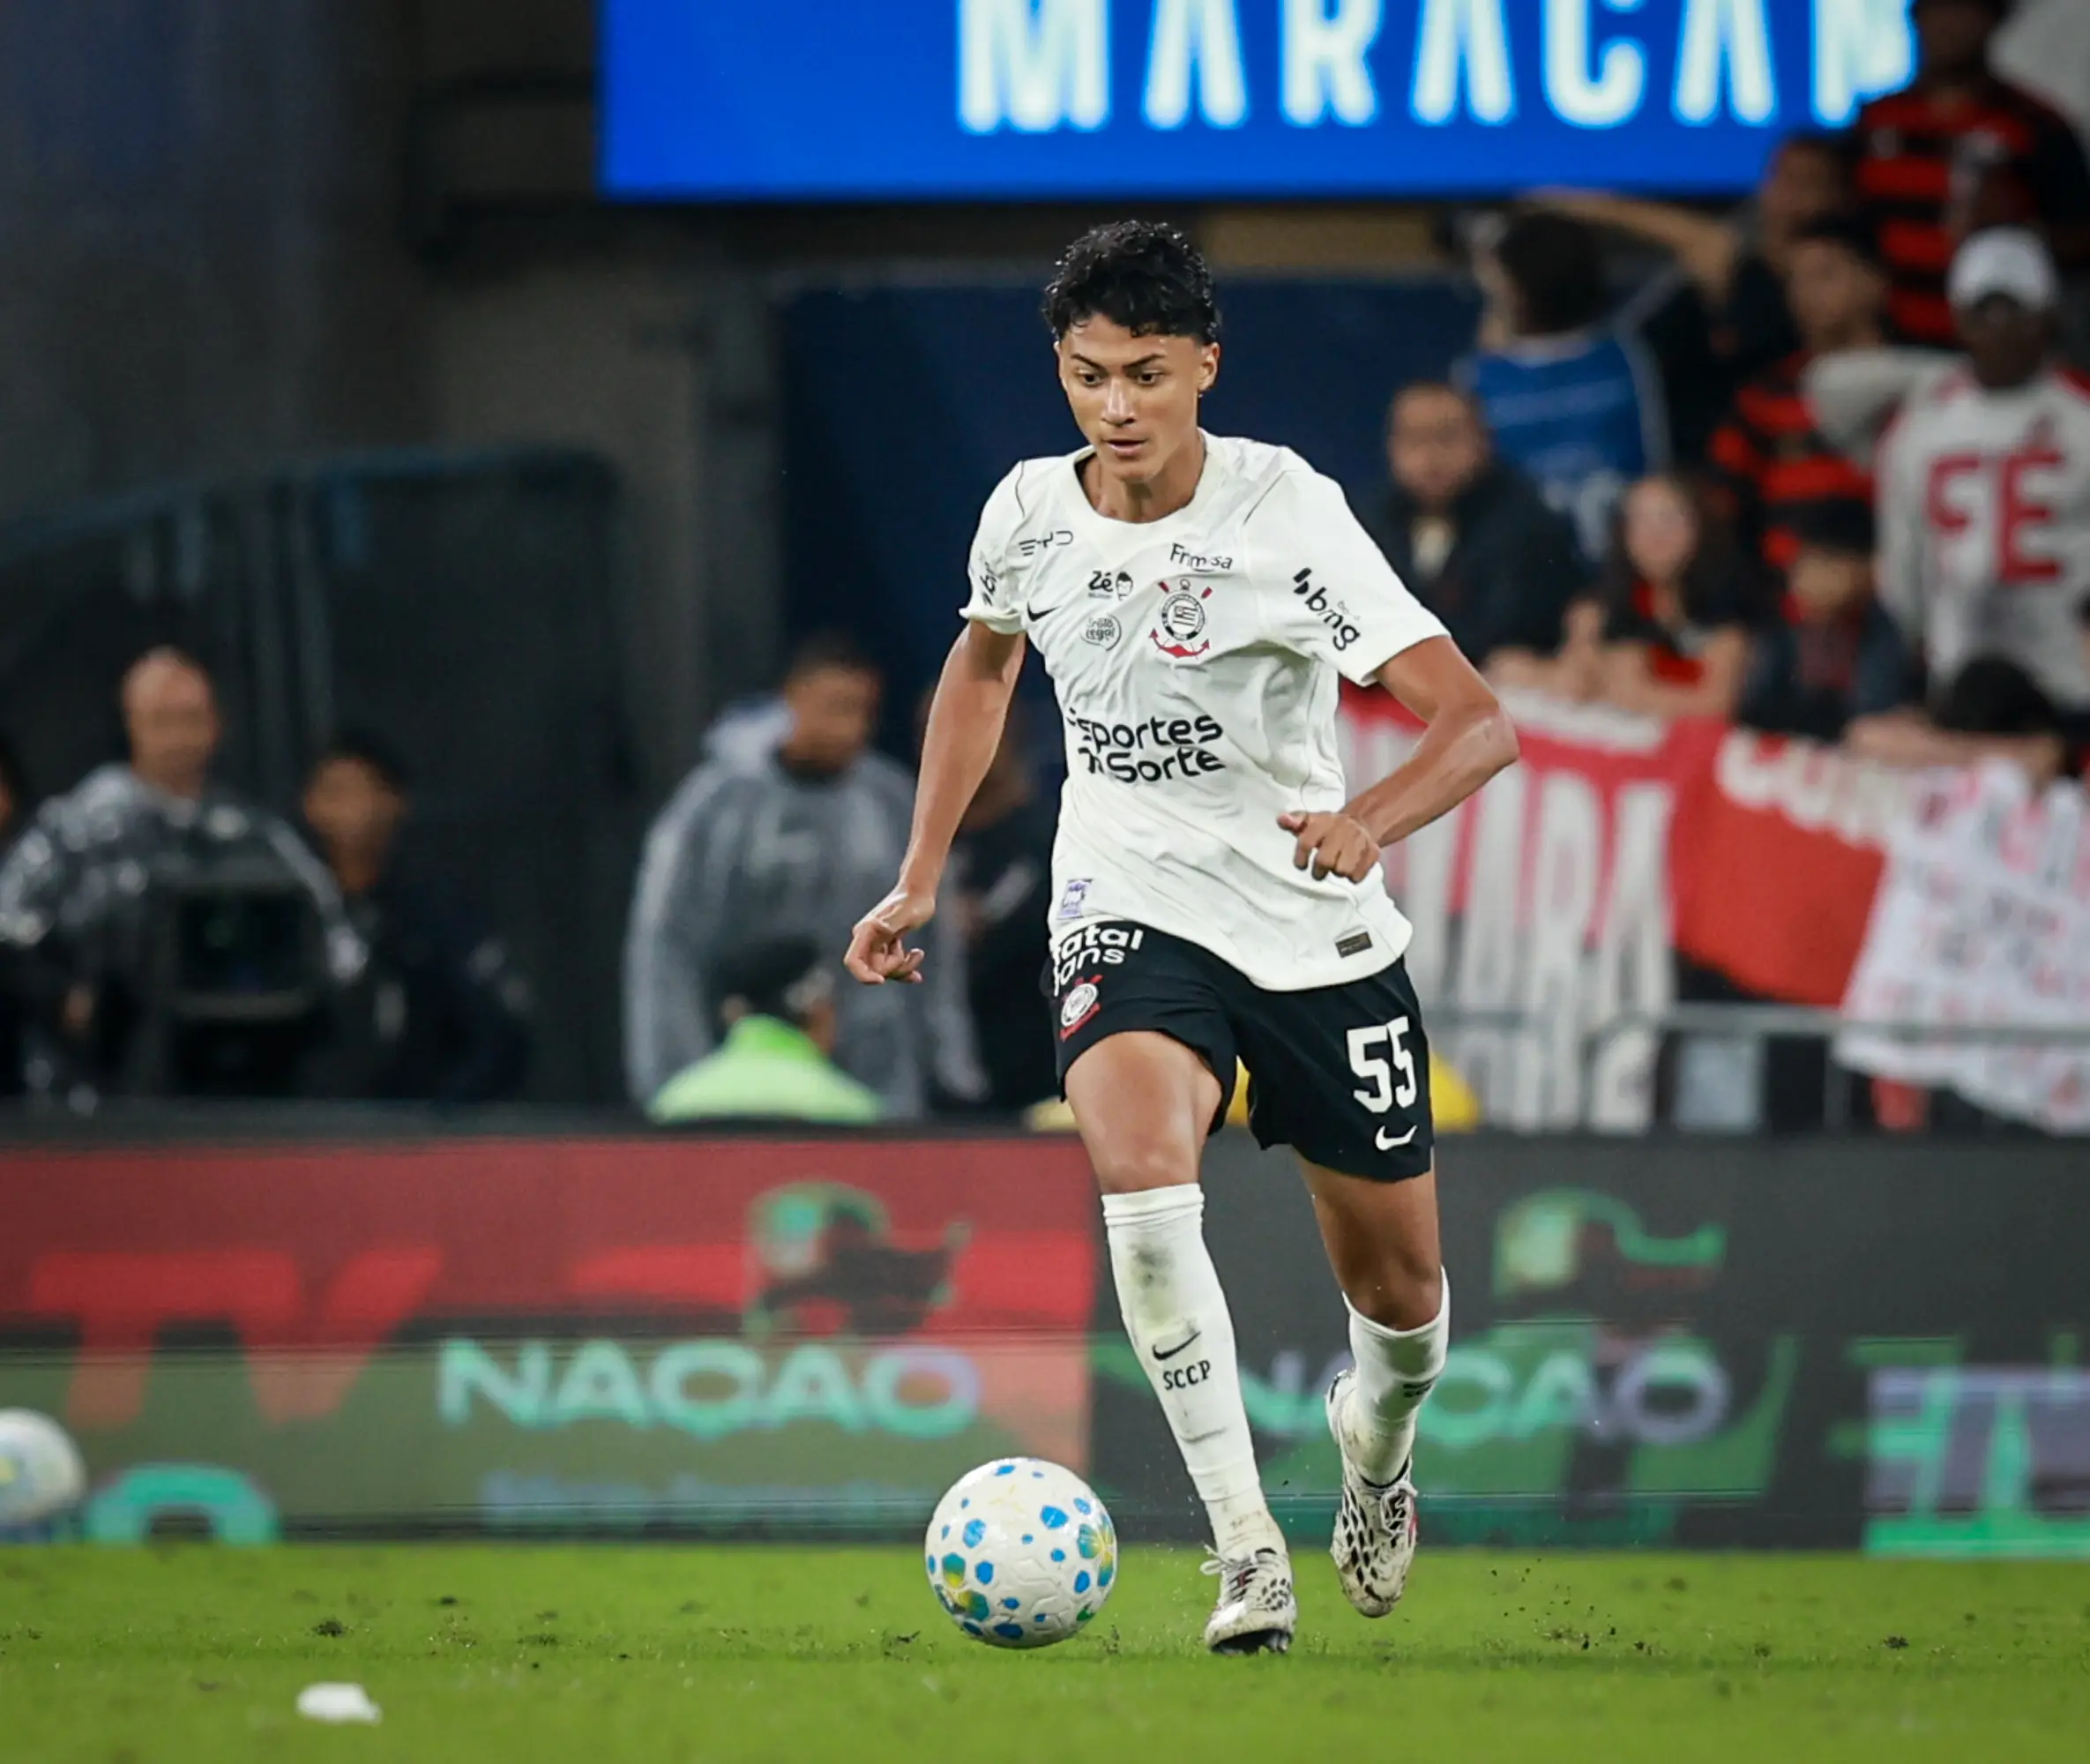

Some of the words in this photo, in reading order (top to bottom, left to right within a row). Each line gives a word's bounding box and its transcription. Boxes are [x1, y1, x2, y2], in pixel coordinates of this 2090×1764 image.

[1304, 586, 1361, 652] bmg
[1106, 746, 1227, 783] Sorte
[1346, 1015, 1417, 1113] 55
[1162, 1359, 1211, 1391] SCCP
